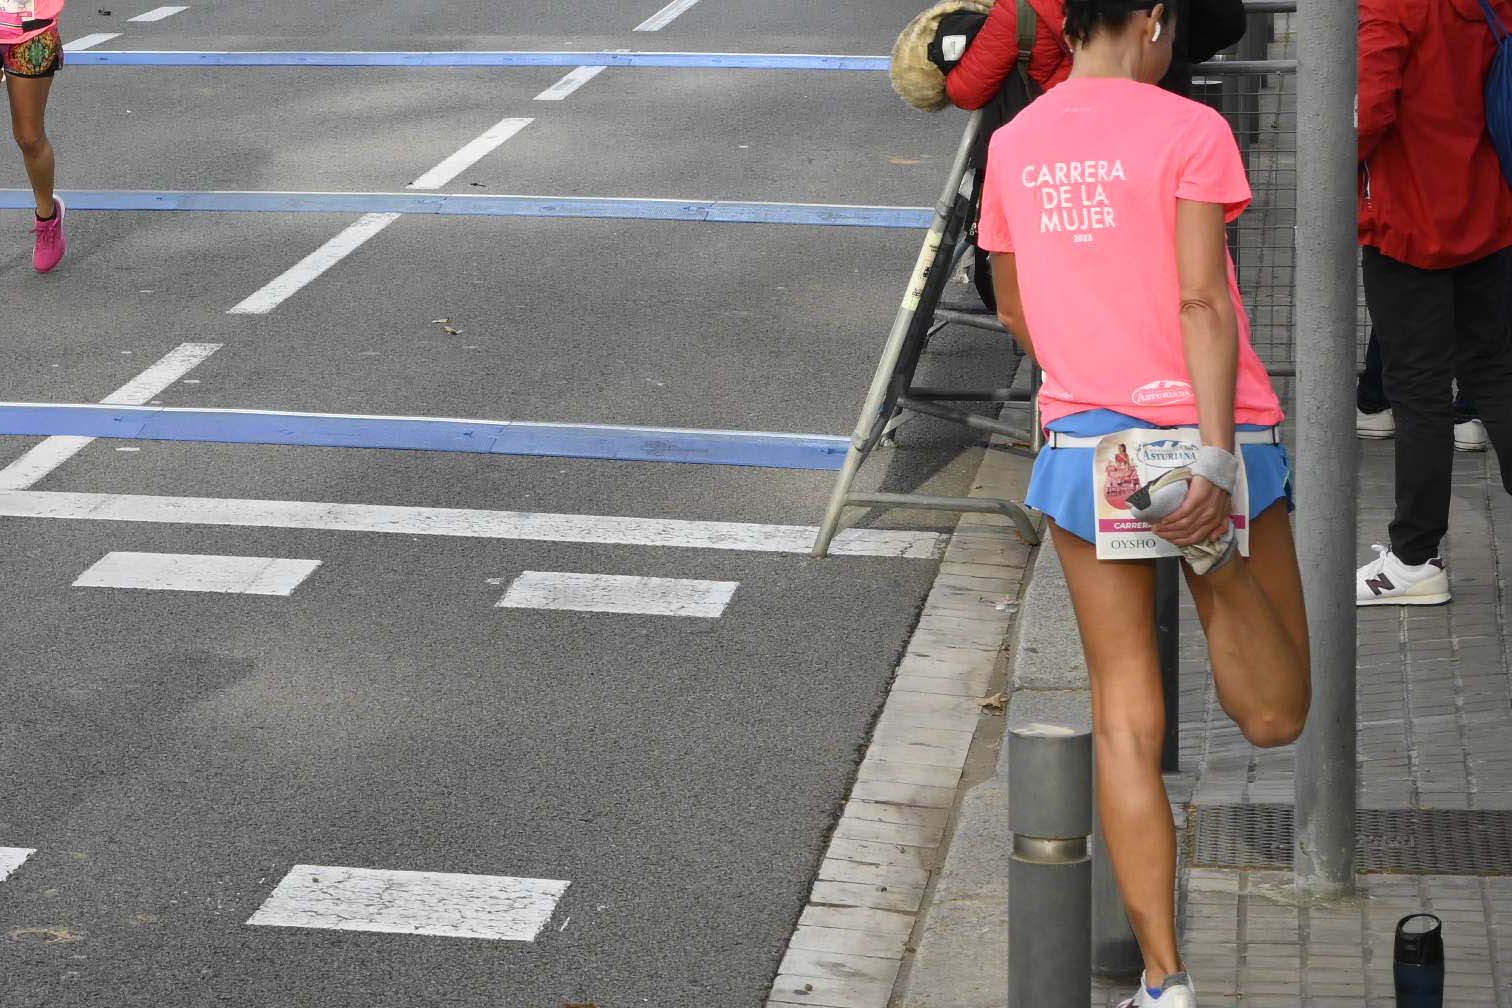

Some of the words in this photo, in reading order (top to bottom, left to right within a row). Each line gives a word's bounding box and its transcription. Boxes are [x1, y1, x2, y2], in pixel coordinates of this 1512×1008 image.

[1021, 159, 1127, 188] CARRERA
[1041, 185, 1073, 209] DE
[1080, 184, 1109, 206] LA
[1040, 206, 1116, 233] MUJER
[1110, 538, 1157, 551] OYSHO
